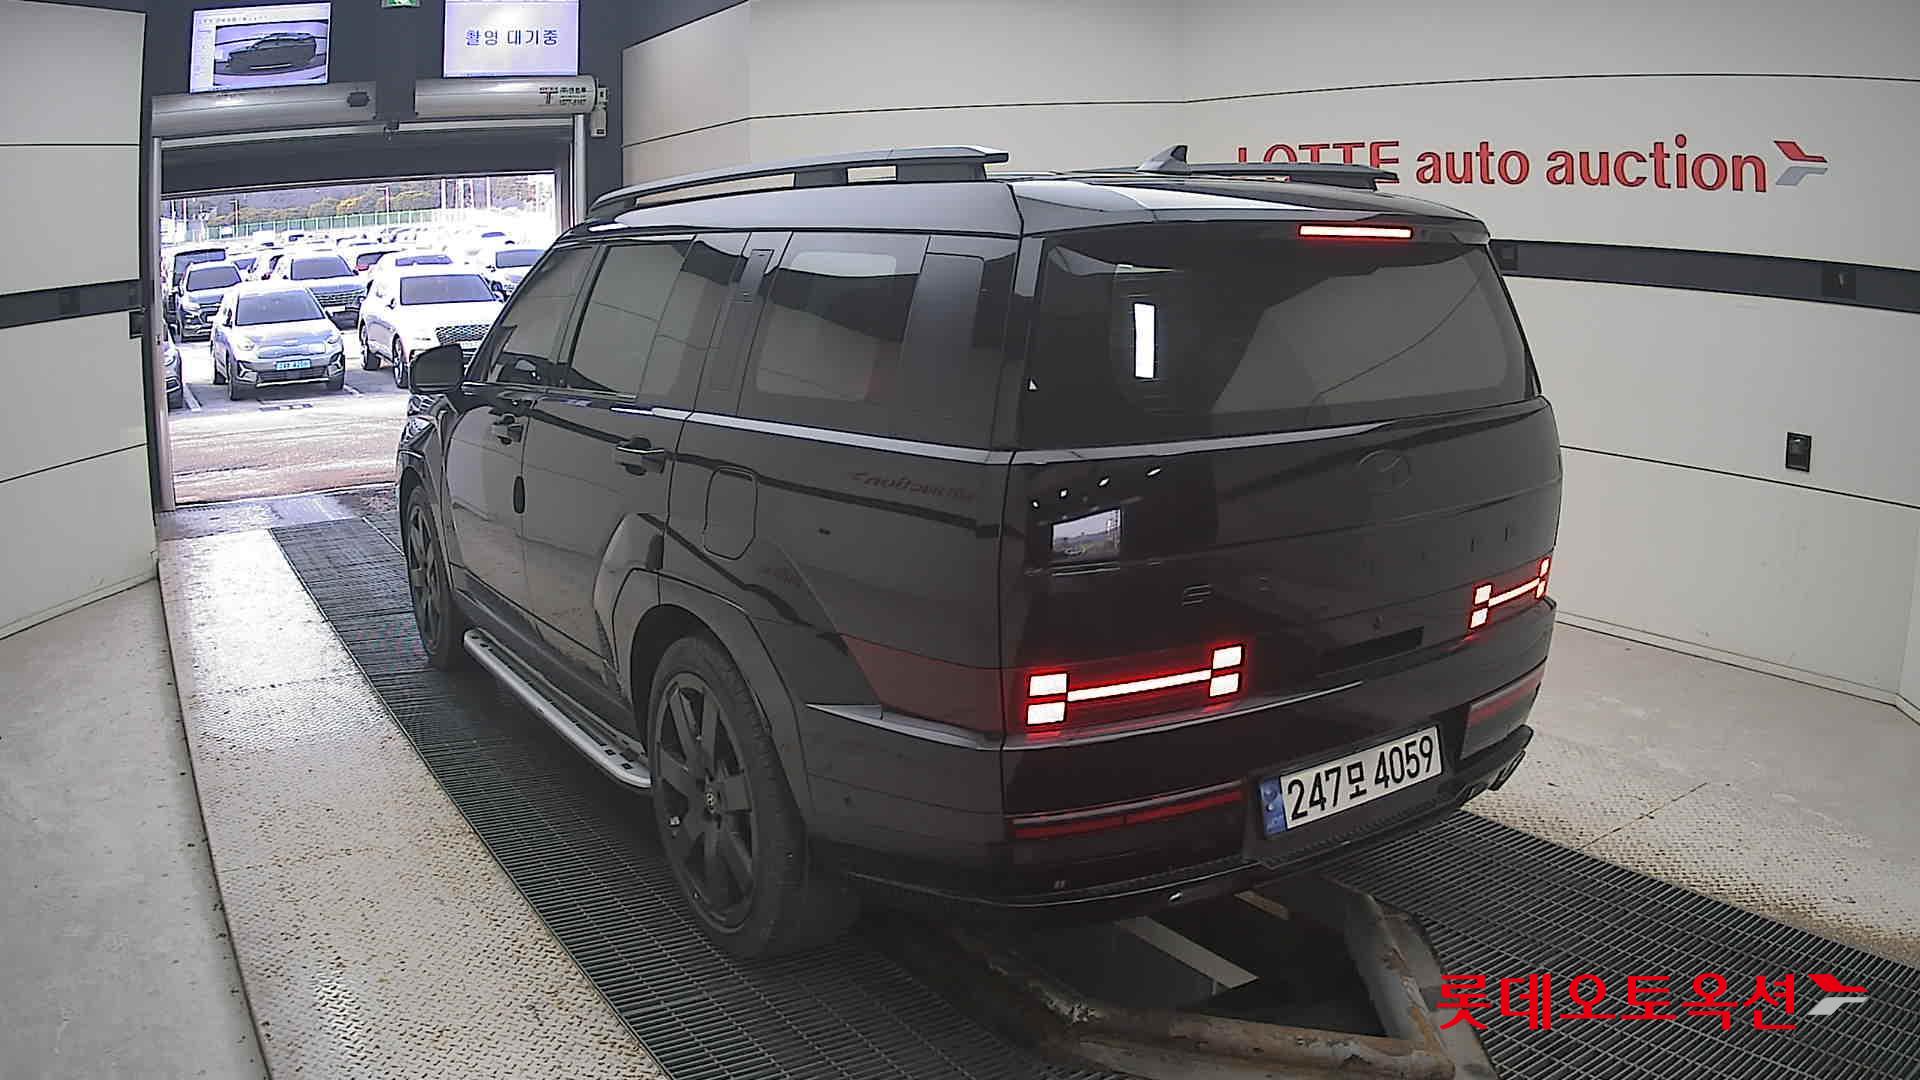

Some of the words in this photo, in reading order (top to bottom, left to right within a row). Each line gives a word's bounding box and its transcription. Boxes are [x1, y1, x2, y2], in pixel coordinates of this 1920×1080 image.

[507, 28, 558, 46] 대기중
[1415, 141, 1529, 185] auto
[1545, 134, 1767, 193] auction
[1287, 761, 1367, 821] 247모
[1374, 735, 1434, 789] 4059
